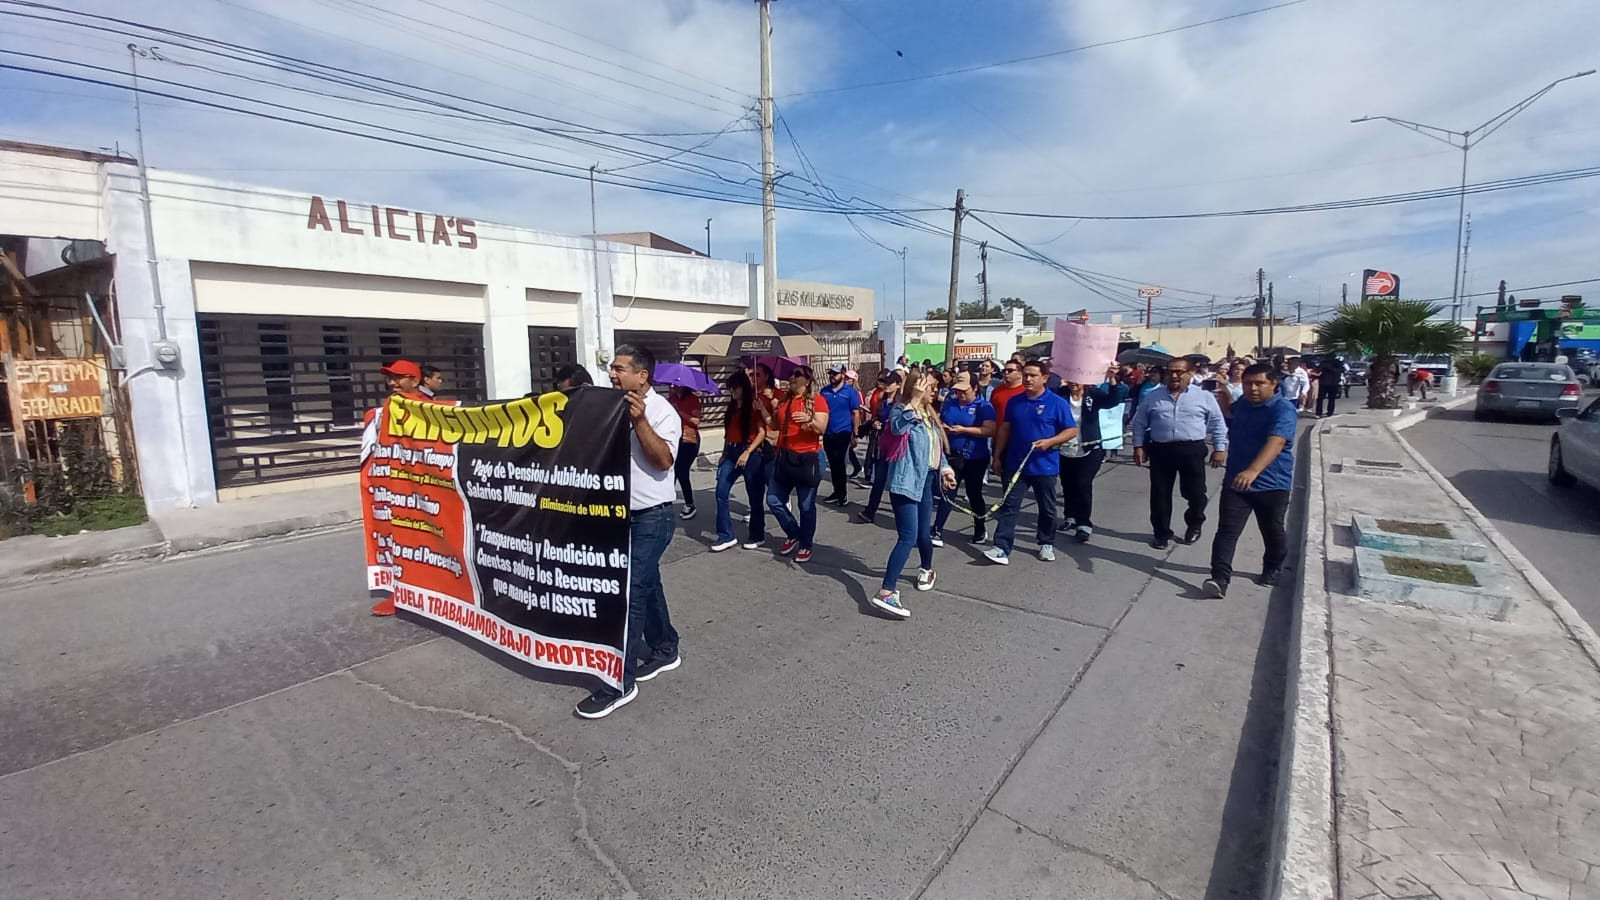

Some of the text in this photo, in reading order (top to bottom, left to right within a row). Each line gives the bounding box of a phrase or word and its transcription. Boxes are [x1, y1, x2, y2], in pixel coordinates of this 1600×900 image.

[307, 196, 477, 250] ALICIA'S
[777, 289, 799, 306] LAS
[16, 363, 99, 384] SISTEMA
[389, 391, 568, 449] EXIGIMOS
[494, 461, 506, 478] de
[508, 461, 544, 484] Pensión
[550, 464, 601, 490] Jubilados
[604, 474, 625, 491] en
[466, 480, 503, 502] Salarios
[577, 504, 588, 515] de
[402, 547, 413, 560] en
[414, 547, 422, 561] el
[480, 524, 628, 569] Transparencia y Rendición de
[477, 547, 620, 595] Cuentas sobre los Recursos
[493, 577, 598, 619] que maneja el ISSSTE
[427, 595, 498, 642] TRABAJAMOS
[499, 624, 532, 657] BAJO
[535, 639, 624, 683] PROTESTA
